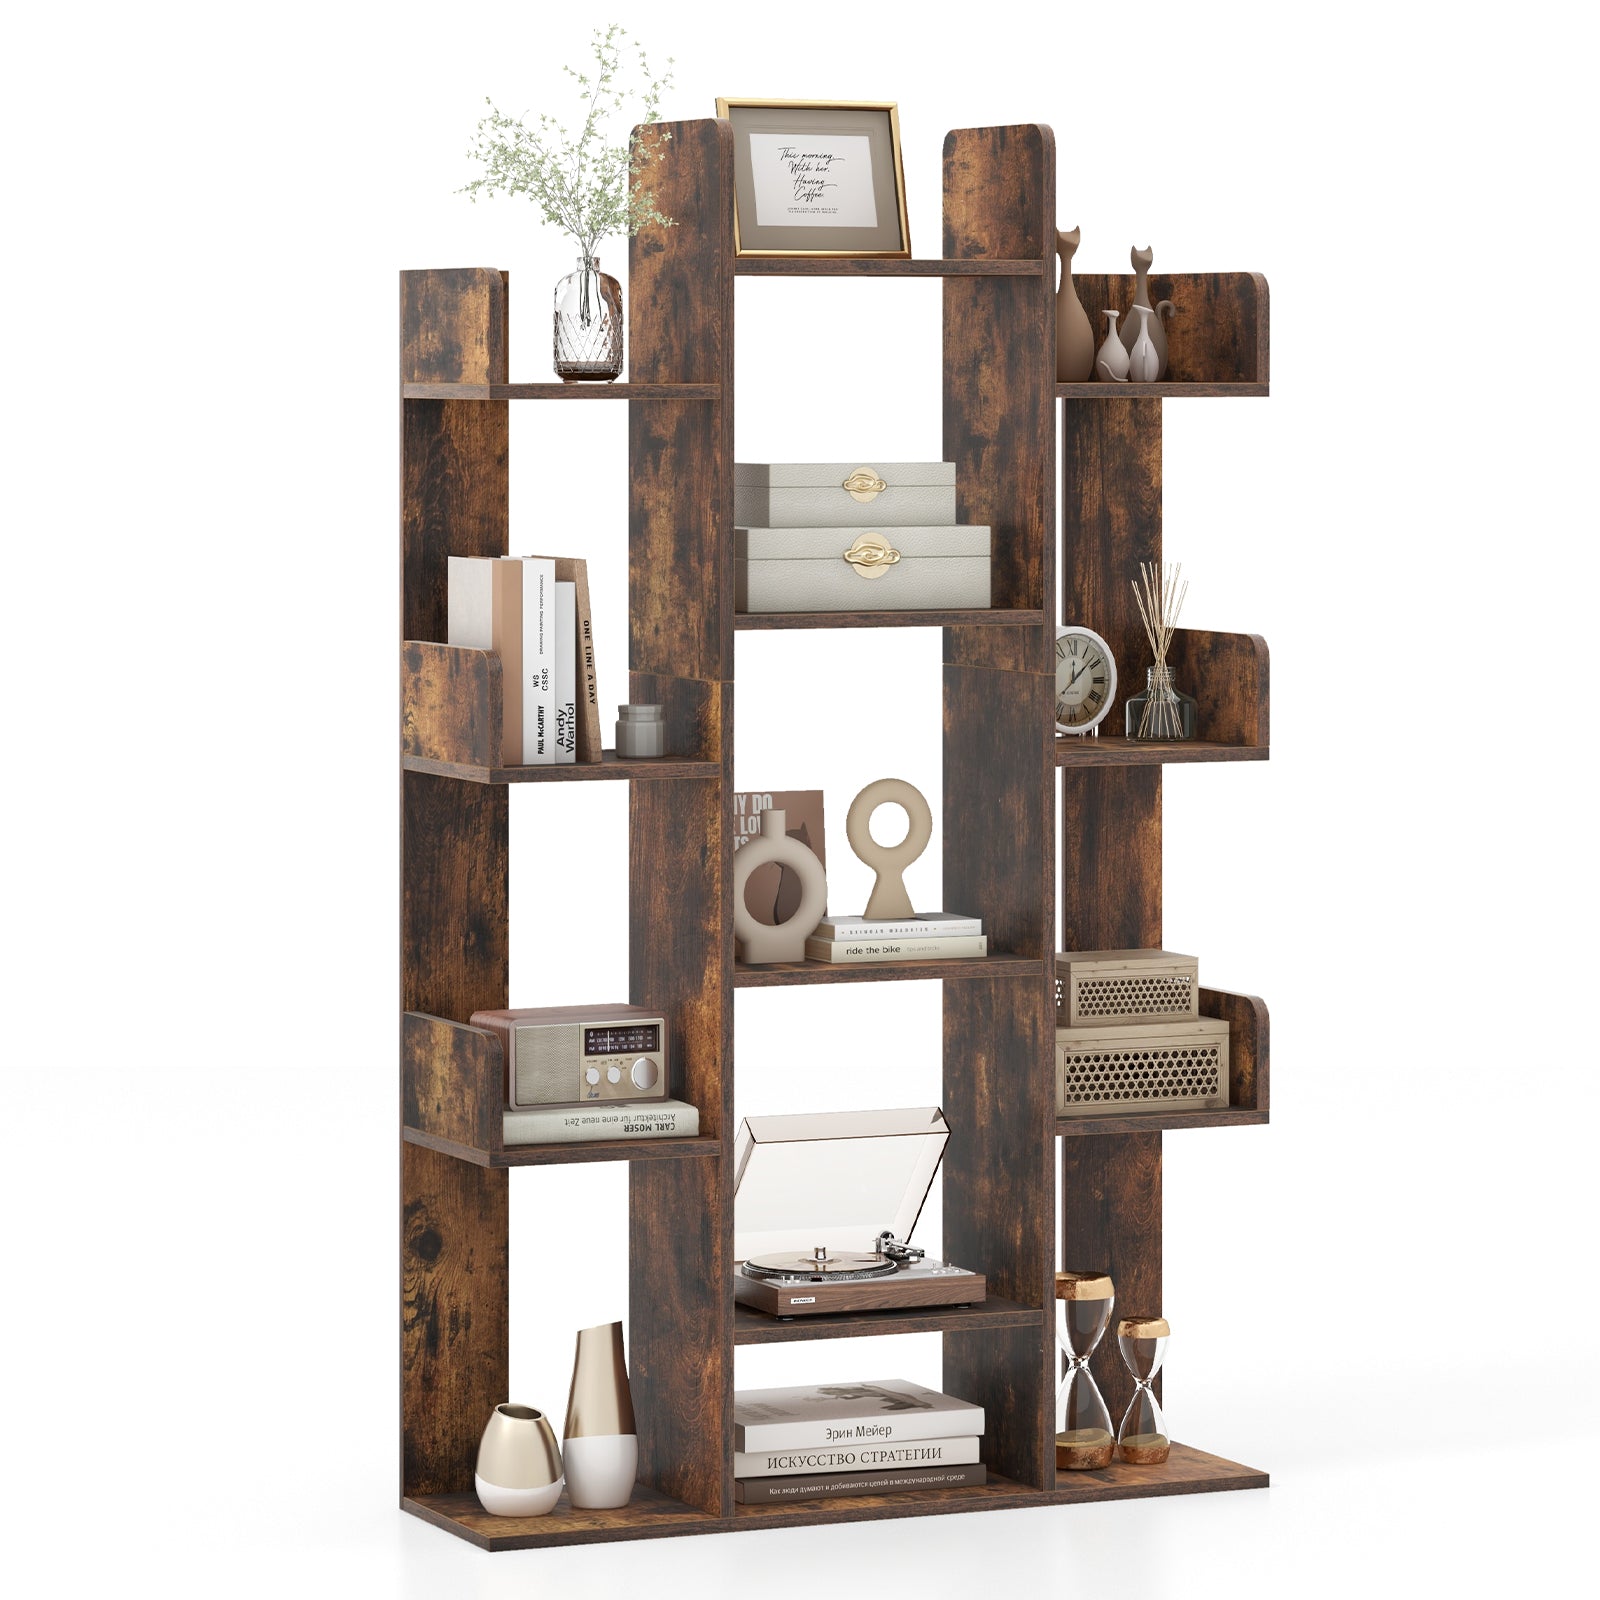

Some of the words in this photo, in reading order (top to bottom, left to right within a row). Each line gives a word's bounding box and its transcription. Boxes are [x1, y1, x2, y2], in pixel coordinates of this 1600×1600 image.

[778, 147, 799, 160] This
[788, 158, 813, 175] With
[793, 172, 838, 191] Having
[583, 620, 591, 641] ONE
[585, 646, 593, 670] LINE
[532, 674, 540, 688] WS
[541, 668, 549, 691] CSSC
[588, 684, 596, 705] DAY
[556, 709, 568, 747] Andy
[565, 702, 575, 754] Warhol
[537, 739, 545, 755] PAUL
[752, 794, 773, 815] DO
[846, 947, 863, 955] ride
[866, 946, 880, 954] the
[882, 945, 901, 953] bike
[564, 1118, 580, 1126] Zeit
[602, 1115, 619, 1123] eine
[620, 1115, 631, 1124] für
[633, 1113, 676, 1121] Architektur
[624, 1123, 652, 1133] MOSER
[655, 1122, 676, 1131] CARL
[826, 1427, 853, 1442] Эрин
[855, 1424, 892, 1438] Мейер
[767, 1452, 856, 1469] ИСКУССТВО
[860, 1447, 942, 1463] СТРАТЕГИИ
[800, 1485, 824, 1493] думают
[830, 1482, 868, 1491] добиваются
[869, 1478, 889, 1488] целей
[894, 1475, 946, 1485] международной
[946, 1474, 966, 1482] среде
